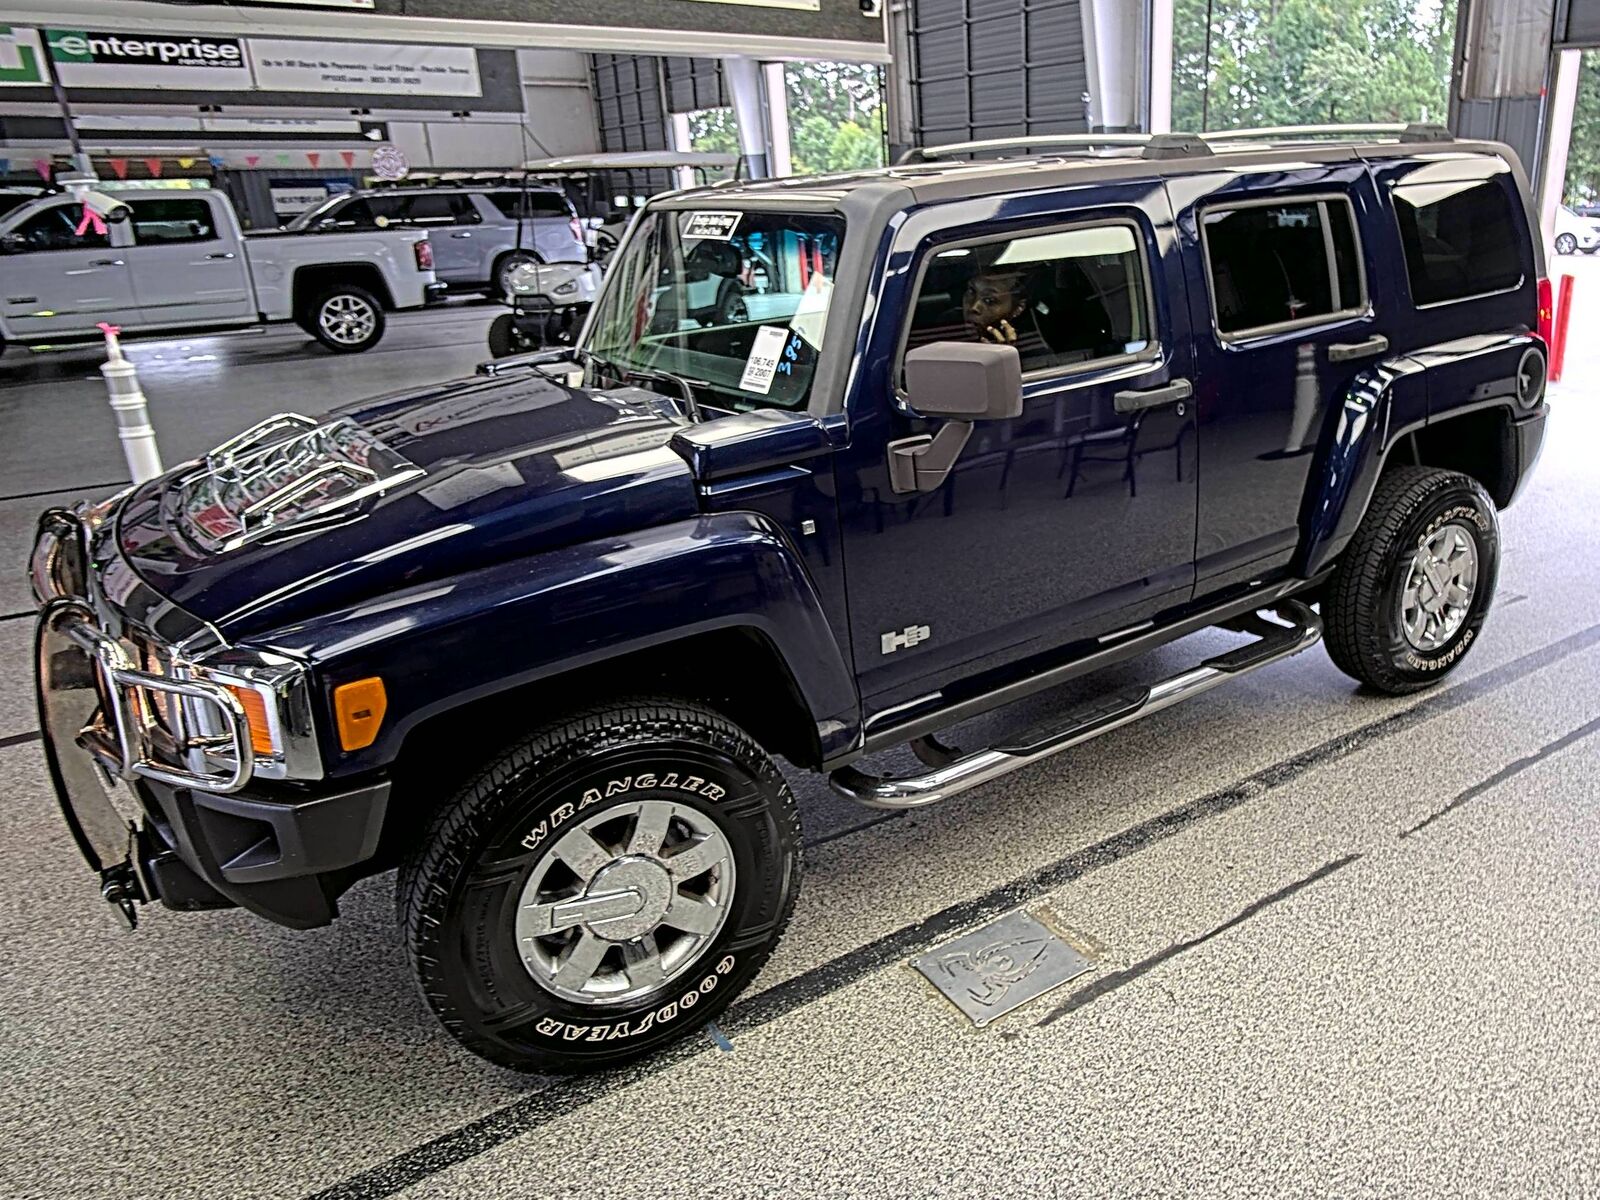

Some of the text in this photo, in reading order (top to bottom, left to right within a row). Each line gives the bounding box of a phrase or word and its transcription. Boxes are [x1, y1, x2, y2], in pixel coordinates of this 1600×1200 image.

[49, 36, 240, 62] enterprise
[881, 625, 931, 655] H3
[521, 773, 726, 850] WRANGLER
[535, 955, 735, 1042] GOODYEAR
